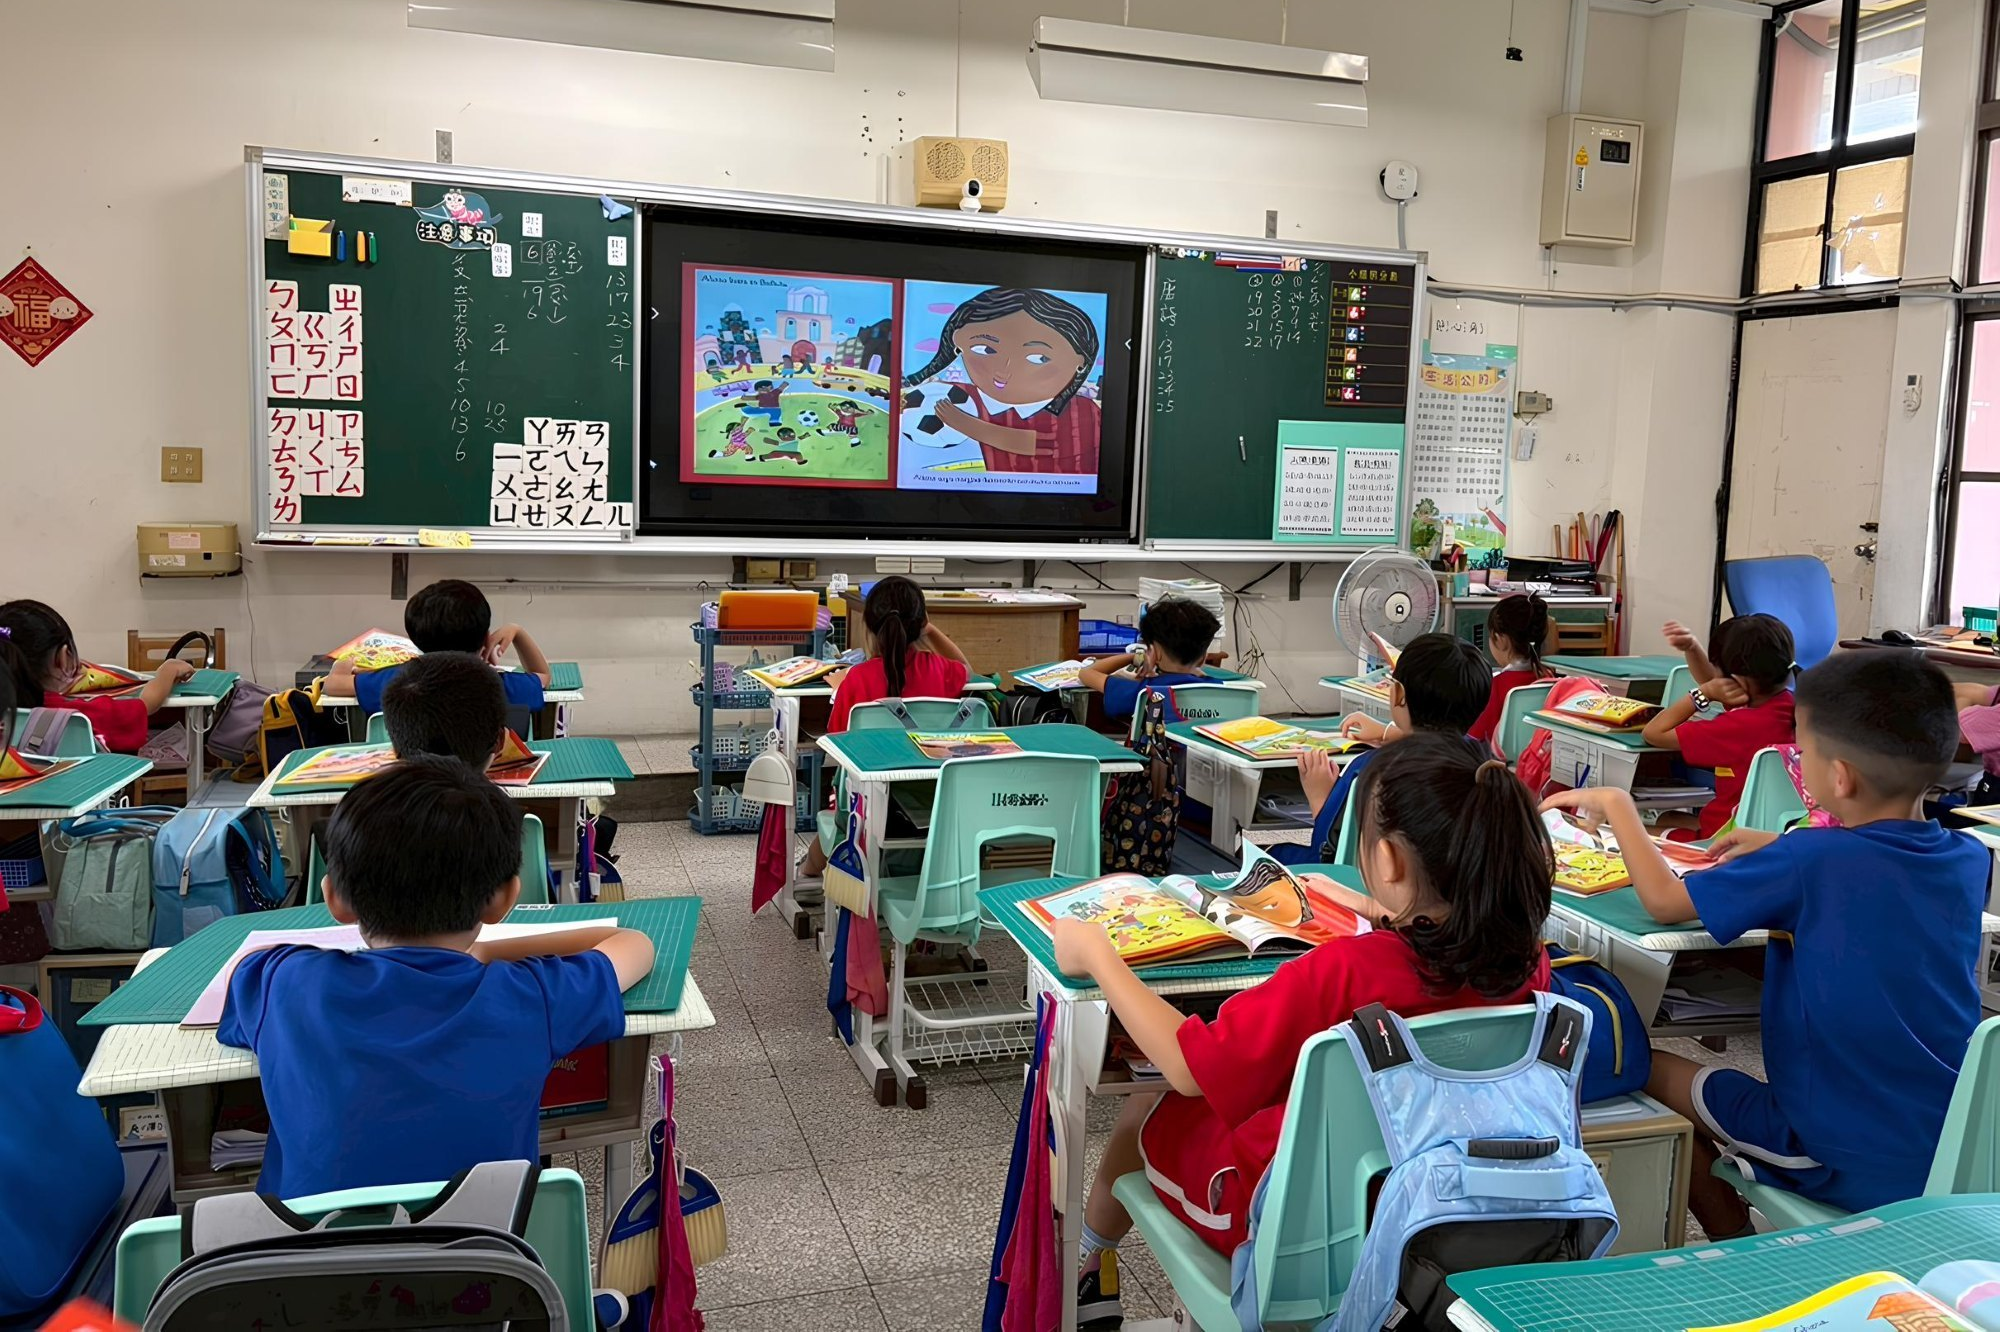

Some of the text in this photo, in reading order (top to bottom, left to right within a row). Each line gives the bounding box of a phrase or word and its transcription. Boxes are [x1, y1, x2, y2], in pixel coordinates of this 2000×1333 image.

[527, 244, 538, 259] 6
[606, 272, 626, 288] 13
[523, 286, 543, 307] 19
[609, 293, 628, 306] 17
[1247, 291, 1263, 304] 19
[13, 293, 52, 329] 福
[527, 305, 537, 319] 6
[1248, 307, 1263, 316] 20
[606, 312, 632, 329] 23
[1246, 319, 1259, 332] 21
[1269, 320, 1284, 332] 15
[494, 323, 507, 334] 2
[489, 338, 510, 355] 4
[609, 335, 624, 348] 3
[1159, 339, 1172, 353] 13
[1244, 336, 1262, 347] 22
[1269, 335, 1283, 350] 17
[454, 360, 468, 373] 4
[611, 354, 630, 372] 4
[1158, 356, 1172, 367] 17
[457, 377, 471, 393] 5
[450, 399, 471, 412] 10
[486, 401, 506, 416] 10
[451, 416, 470, 434] 13
[484, 419, 507, 434] 25
[455, 439, 466, 461] 6
